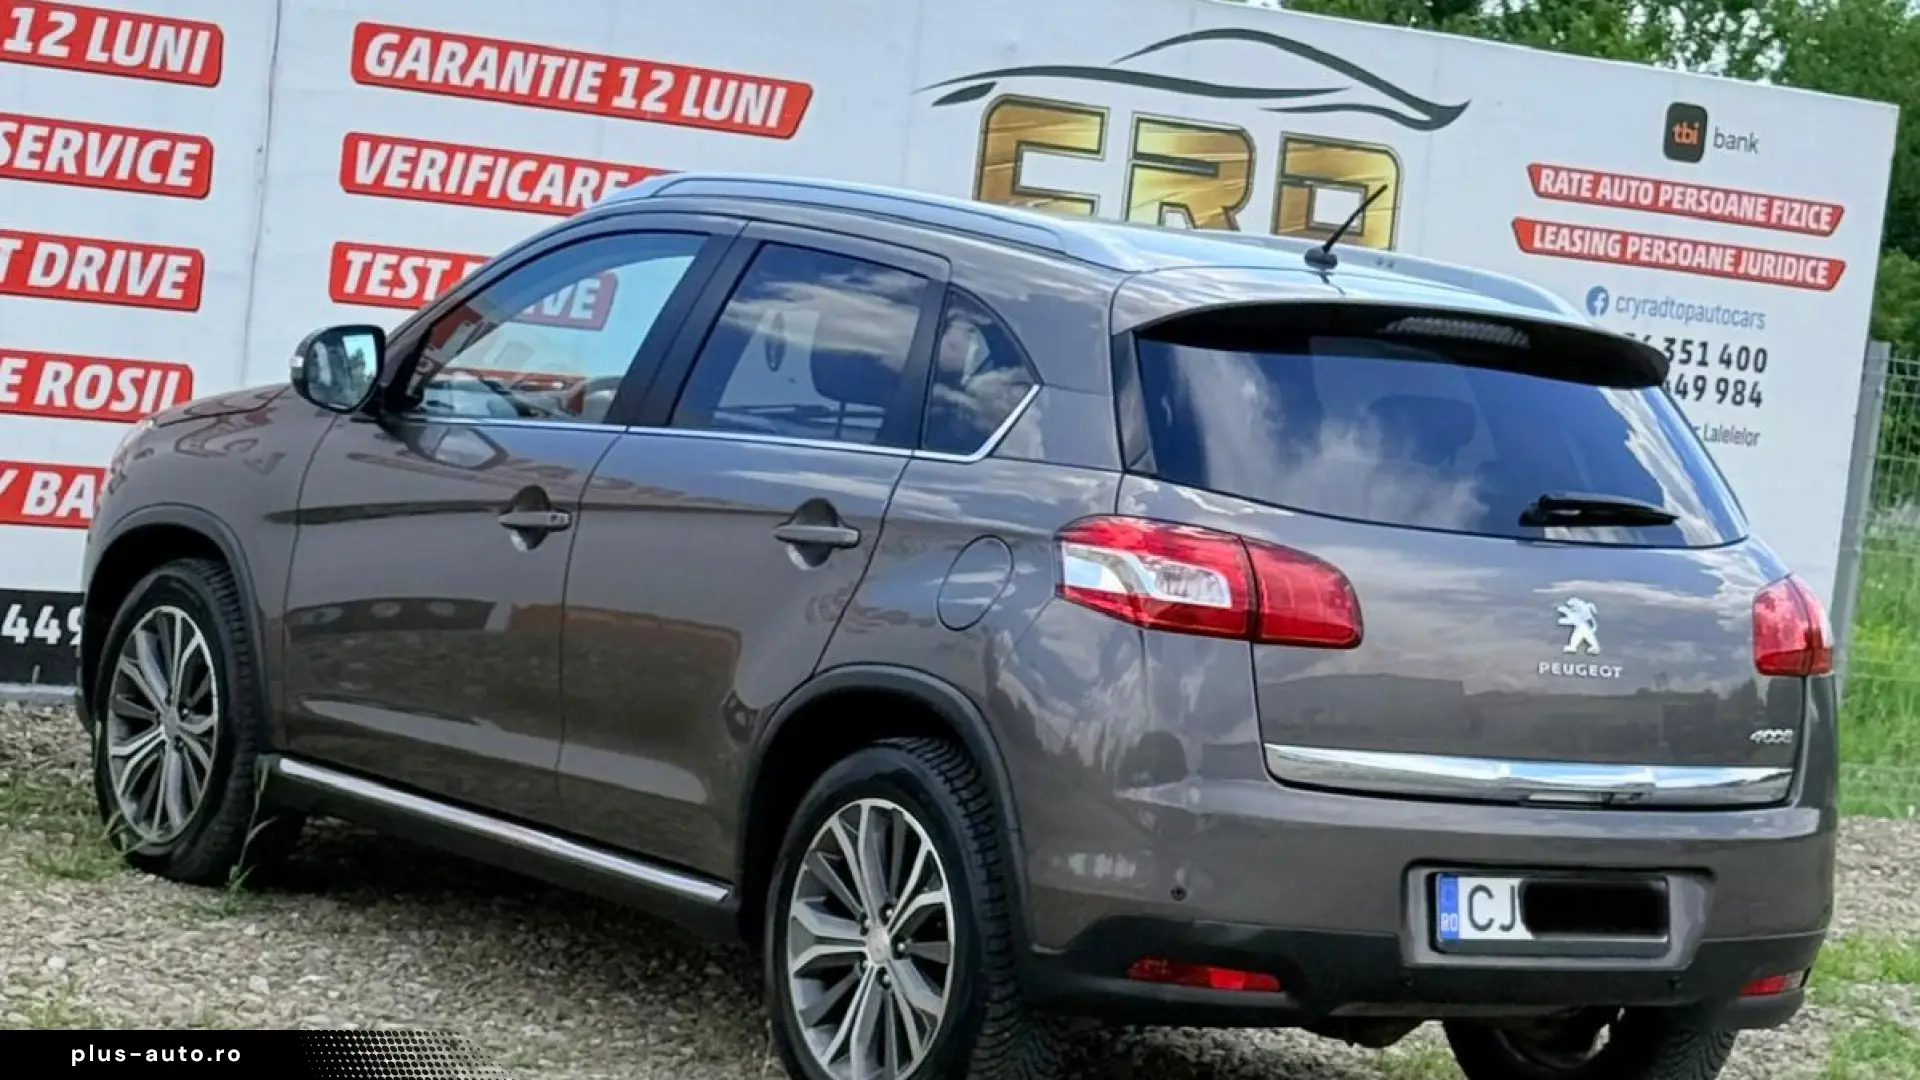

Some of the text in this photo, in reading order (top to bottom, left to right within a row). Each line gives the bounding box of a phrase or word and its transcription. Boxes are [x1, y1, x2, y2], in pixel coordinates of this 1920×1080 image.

[3, 6, 211, 76] 12 LUNI
[363, 32, 788, 129] GARANTIE 12 LUNI
[0, 120, 201, 188] SERVICE
[1672, 121, 1760, 154] tbi bank
[354, 141, 631, 208] VERIFICARE
[1538, 168, 1834, 232] RATE AUTO PERSOANE FIZICE
[27, 241, 193, 301] DRIVE
[343, 249, 452, 301] TEST
[1533, 223, 1830, 285] LEASING PERSOANE JURIDICE
[1615, 294, 1767, 331] cryradtopautocars
[1662, 336, 1709, 368] 351
[1718, 343, 1768, 374] 400
[33, 360, 181, 415] ROSII
[1714, 376, 1763, 409] 984
[1538, 661, 1624, 679] PEUGEOT
[1440, 912, 1459, 932] RO
[1467, 884, 1516, 932] CJ
